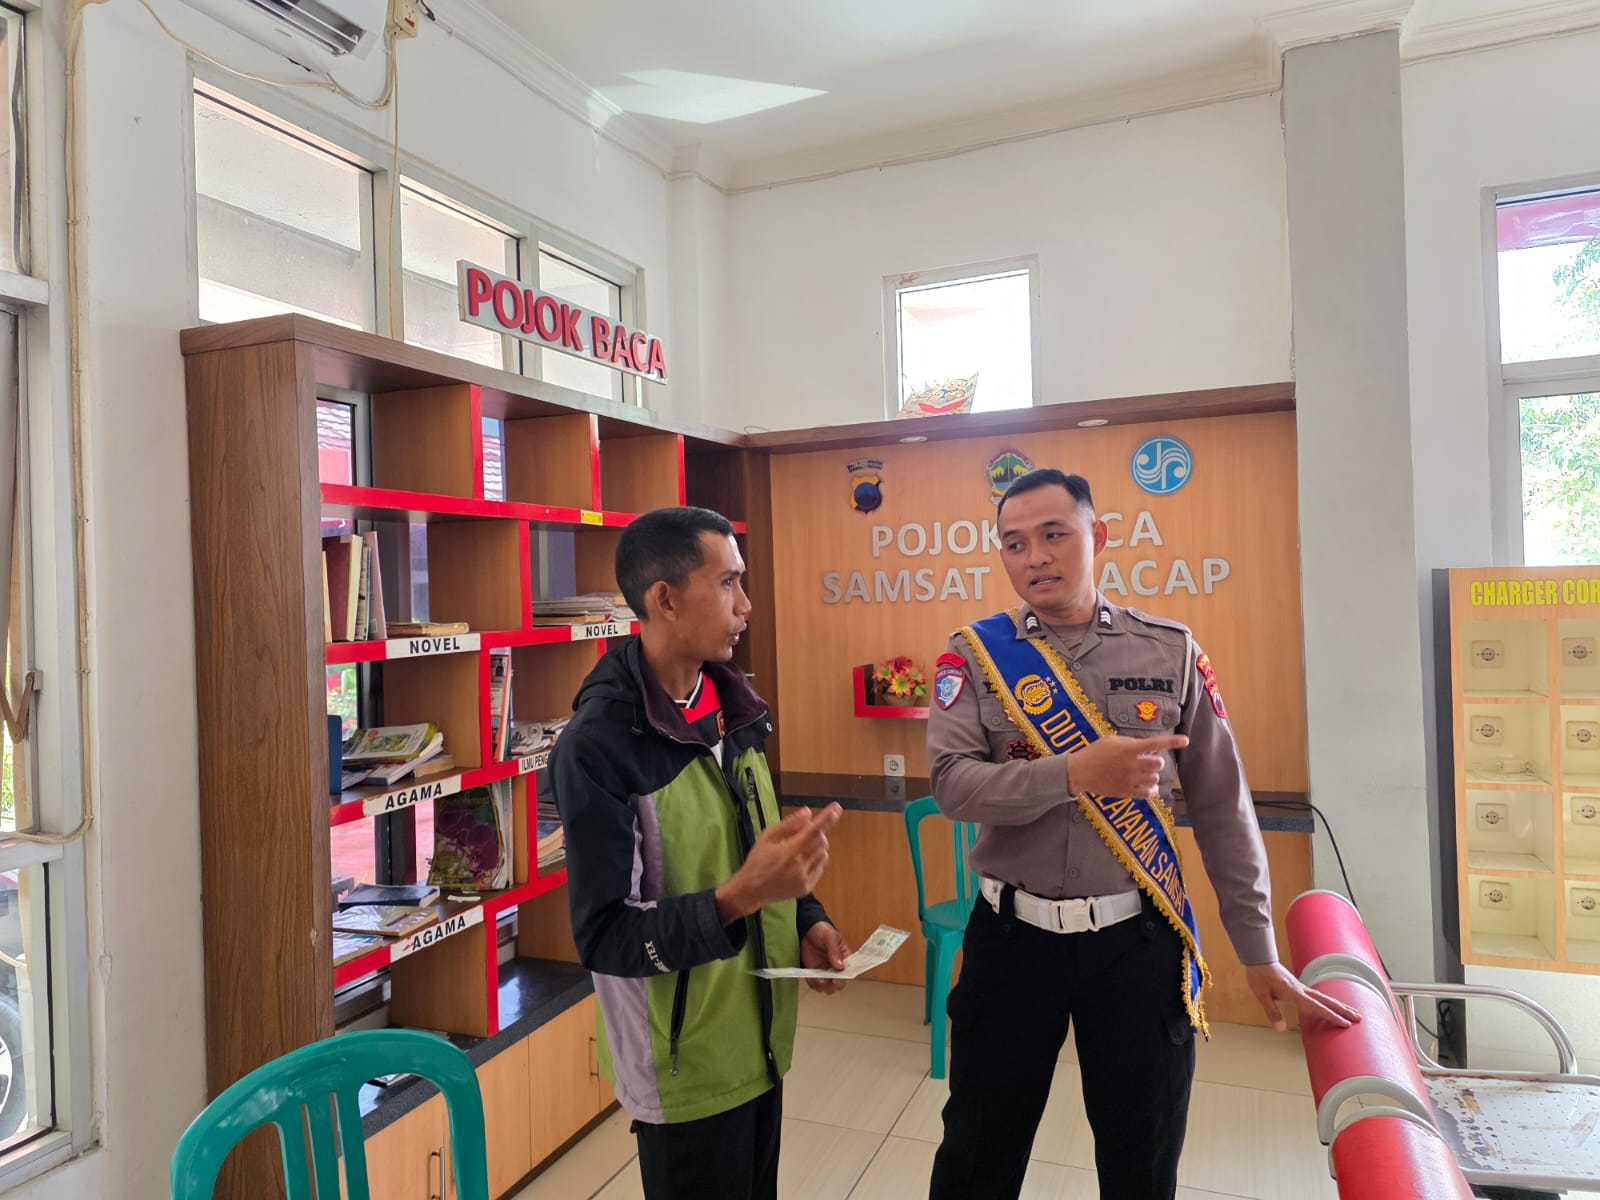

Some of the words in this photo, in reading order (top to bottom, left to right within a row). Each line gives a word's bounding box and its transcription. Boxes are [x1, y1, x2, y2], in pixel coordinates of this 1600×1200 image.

[467, 268, 583, 352] POJOK
[591, 316, 666, 378] BACA
[872, 519, 1002, 558] POJOK
[1101, 511, 1164, 548] CA
[822, 566, 990, 604] SAMSAT
[1098, 558, 1231, 596] ACAP
[1470, 580, 1558, 607] CHARGER
[1562, 578, 1600, 605] COR
[409, 636, 461, 654] NOVEL
[585, 623, 619, 638] NOVEL
[1109, 677, 1174, 693] POLRI
[1040, 709, 1088, 754] DUT
[384, 782, 443, 811] AGAMA
[411, 915, 467, 951] AGAMA
